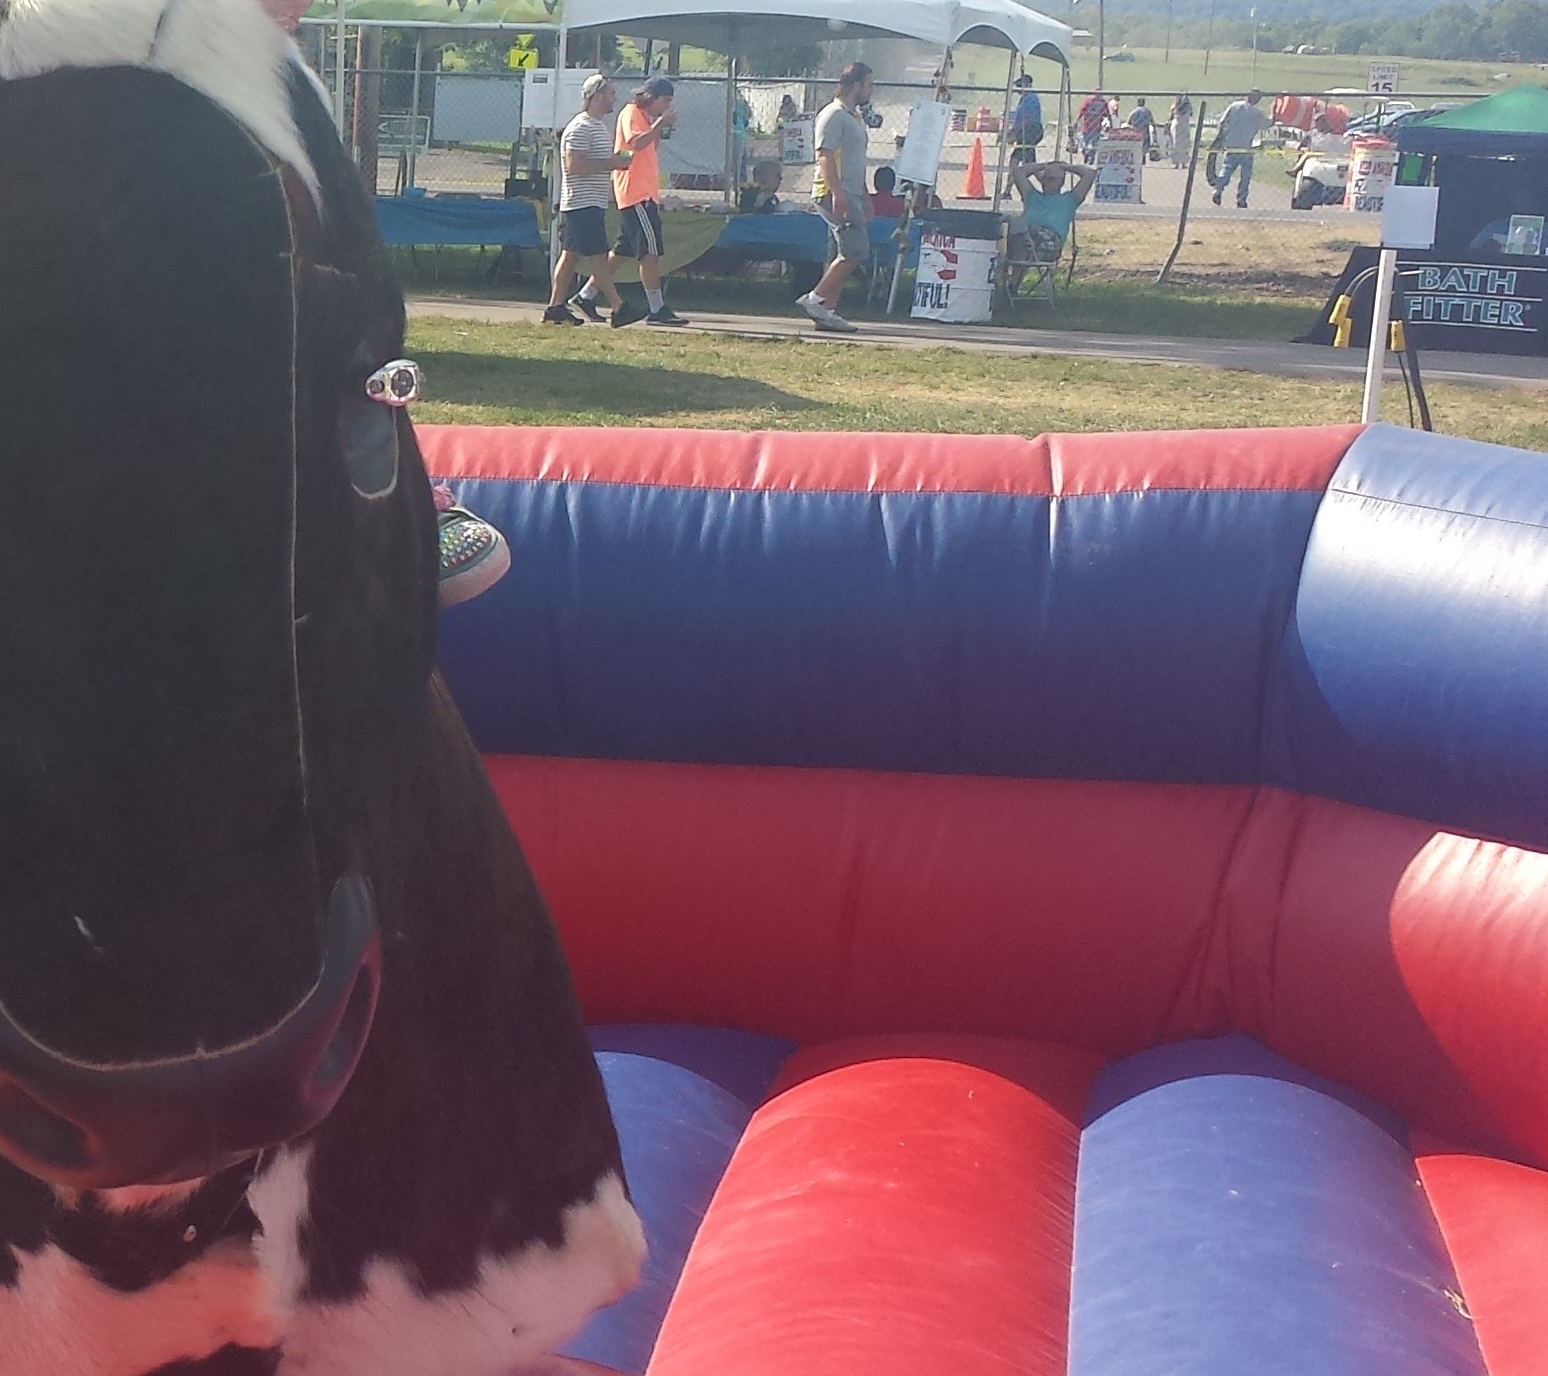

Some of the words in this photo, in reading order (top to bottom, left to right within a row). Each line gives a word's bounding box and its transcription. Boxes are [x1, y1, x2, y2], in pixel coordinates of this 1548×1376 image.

[1371, 82, 1393, 92] 15
[1418, 266, 1517, 295] BATH
[1404, 296, 1525, 326] FITTER
